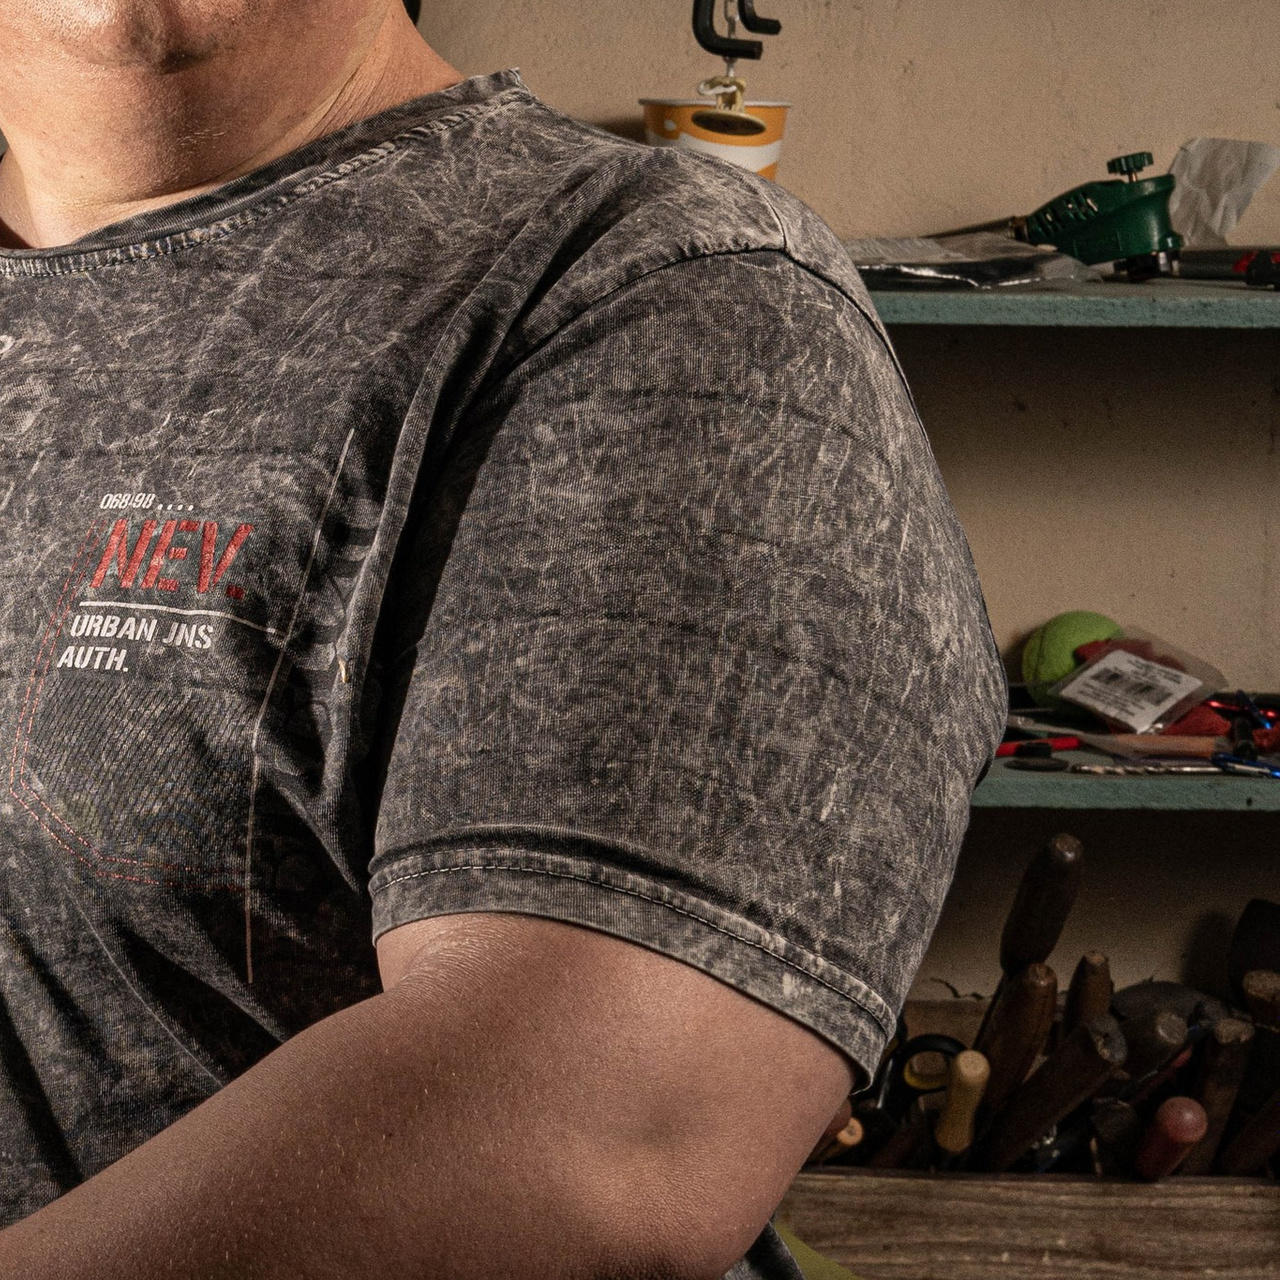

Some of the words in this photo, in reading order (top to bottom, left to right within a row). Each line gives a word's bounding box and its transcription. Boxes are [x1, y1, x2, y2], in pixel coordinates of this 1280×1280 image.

[69, 614, 158, 642] URBAN
[162, 622, 215, 649] JNS
[57, 645, 129, 673] AUTH.
